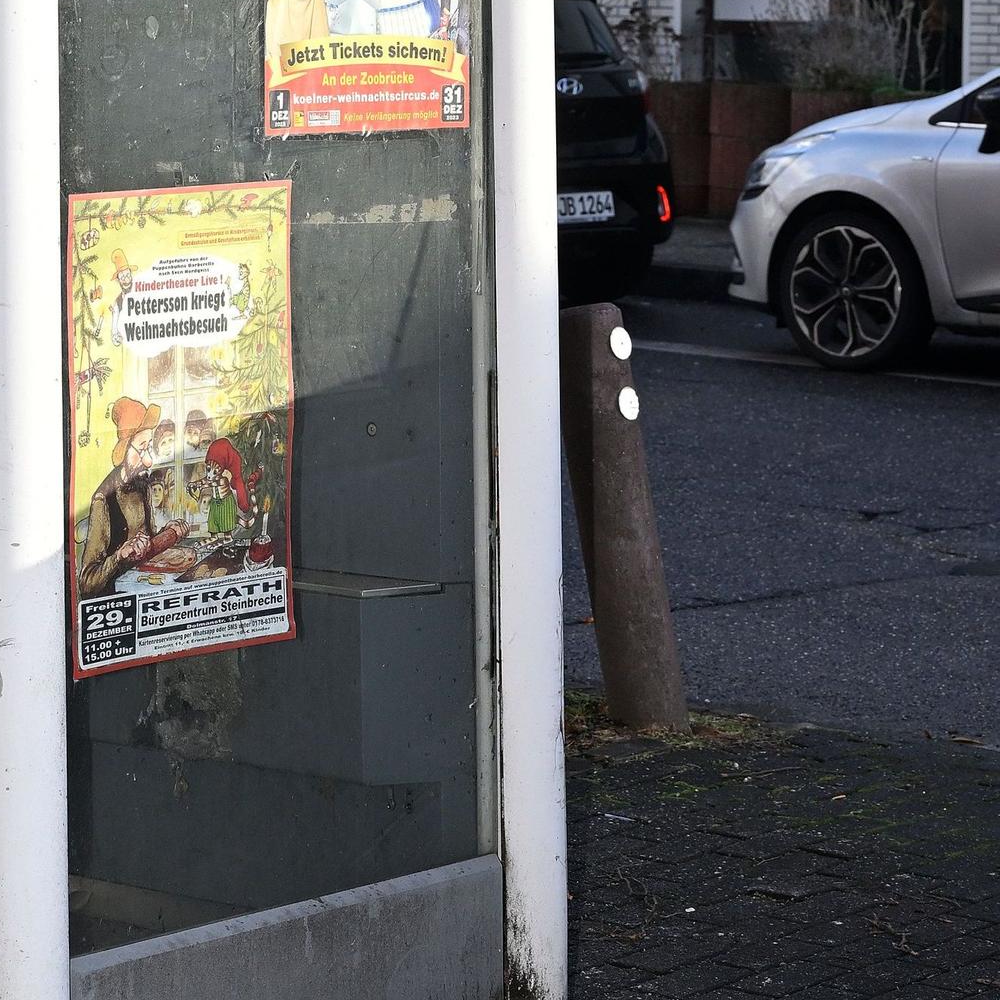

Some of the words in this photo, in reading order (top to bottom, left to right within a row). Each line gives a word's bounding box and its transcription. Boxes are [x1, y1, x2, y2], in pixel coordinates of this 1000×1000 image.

[287, 44, 326, 66] Jetzt
[328, 41, 384, 60] Tickets
[387, 41, 447, 63] sichern!
[322, 72, 337, 86] An
[340, 73, 358, 86] der
[359, 71, 415, 86] Zoobrücke
[277, 92, 284, 110] 1
[292, 89, 440, 105] koelner-weihnachtscircus.de
[444, 86, 462, 104] 31
[271, 110, 289, 121] DEZ
[443, 104, 463, 114] DEZ
[579, 194, 613, 215] 1264
[134, 278, 199, 293] Kindertheater
[201, 275, 218, 286] Live
[127, 295, 188, 316] Pettersson
[191, 289, 226, 311] kriegt
[124, 313, 228, 342] Weihnachtsbesuch
[141, 579, 282, 613] REFRATH
[85, 599, 132, 613] Freitag
[141, 604, 218, 627] Bürgerzentrum
[220, 594, 283, 613] Steinbreche
[86, 609, 133, 631] 29.
[86, 624, 132, 640] DEZEMBER
[138, 634, 183, 646] Kartenreservierung
[183, 632, 192, 640] per
[227, 623, 238, 631] SMS
[84, 640, 112, 653] 11.00
[85, 650, 112, 662] 15.00
[114, 646, 134, 656] Uhr
